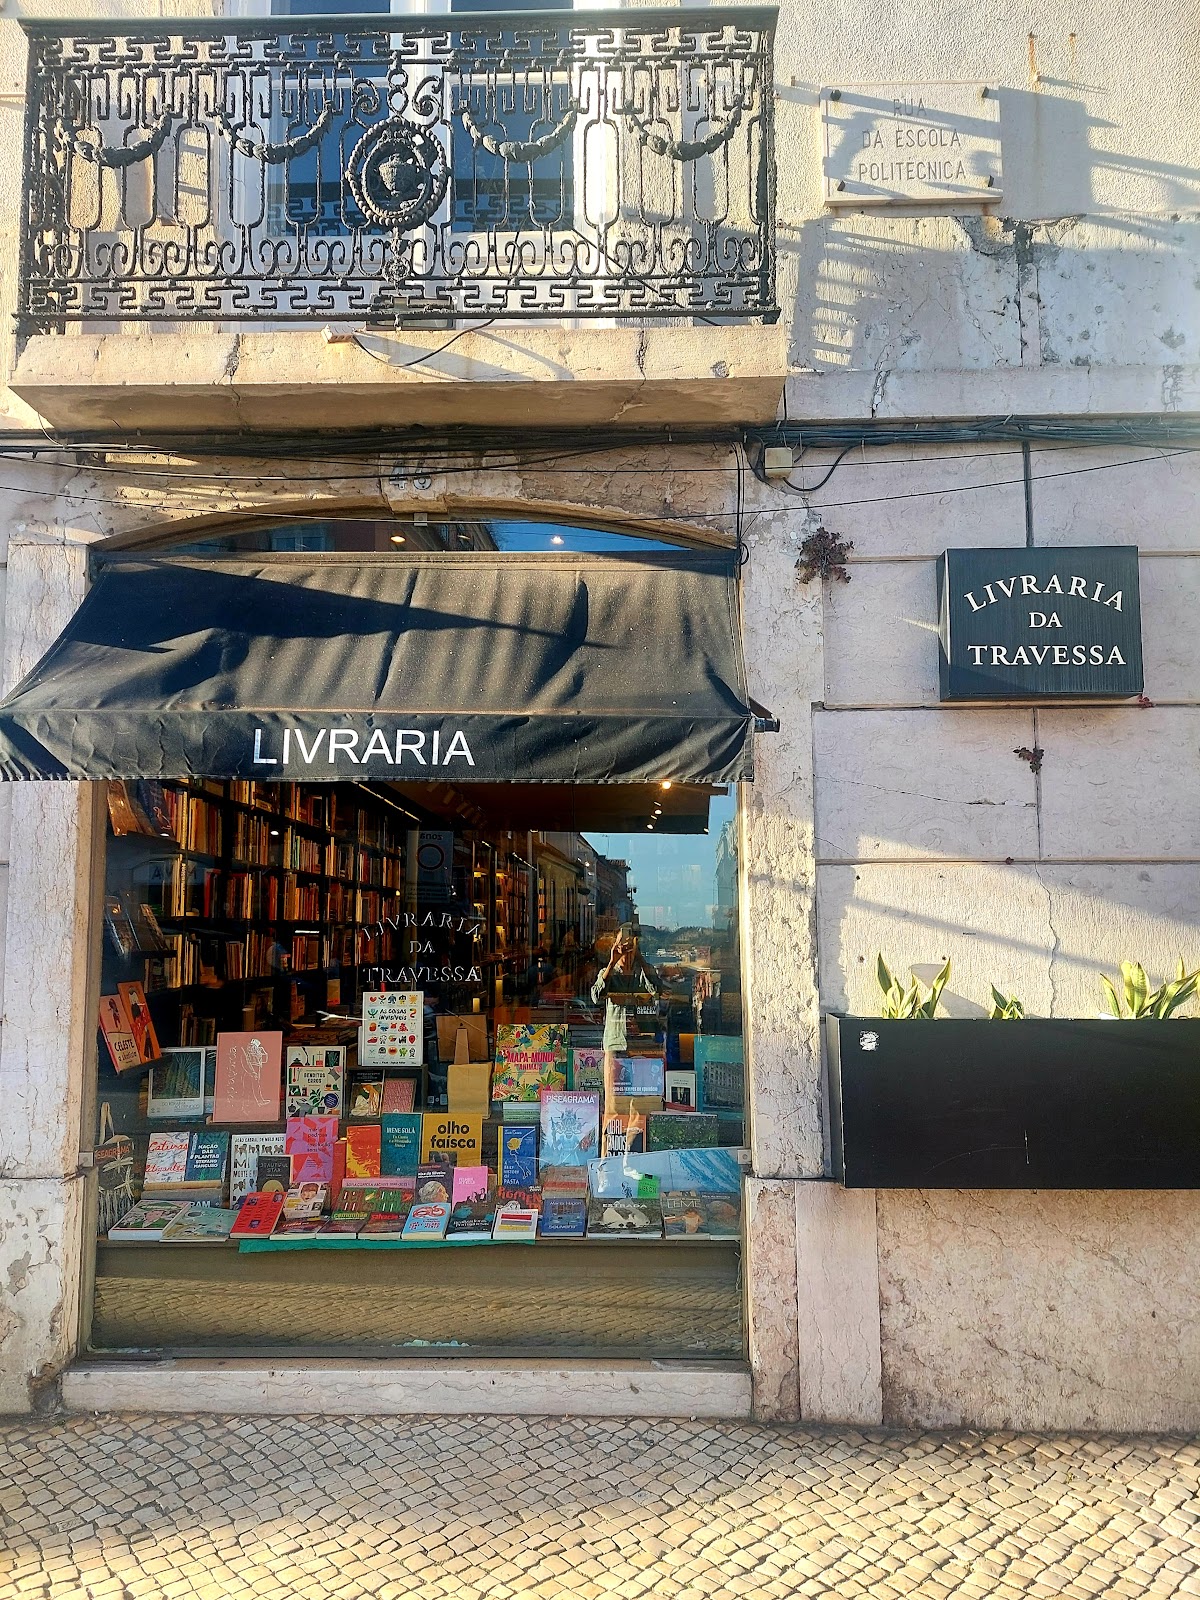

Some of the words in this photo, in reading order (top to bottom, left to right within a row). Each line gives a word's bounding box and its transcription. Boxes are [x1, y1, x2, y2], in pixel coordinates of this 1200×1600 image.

[893, 98, 927, 116] RUA
[862, 130, 884, 148] DA
[895, 129, 961, 148] ESCOLA
[963, 574, 1124, 613] LIVRARIA
[1028, 611, 1064, 629] DA
[967, 645, 1127, 666] TRAVESSA
[253, 728, 476, 766] LIVRARIA
[362, 911, 480, 941] LIVRARIA
[409, 940, 435, 954] DA
[362, 966, 482, 983] TRAVESSA
[114, 1038, 135, 1052] CELESTE
[437, 1121, 470, 1135] olho
[430, 1135, 476, 1149] faísca
